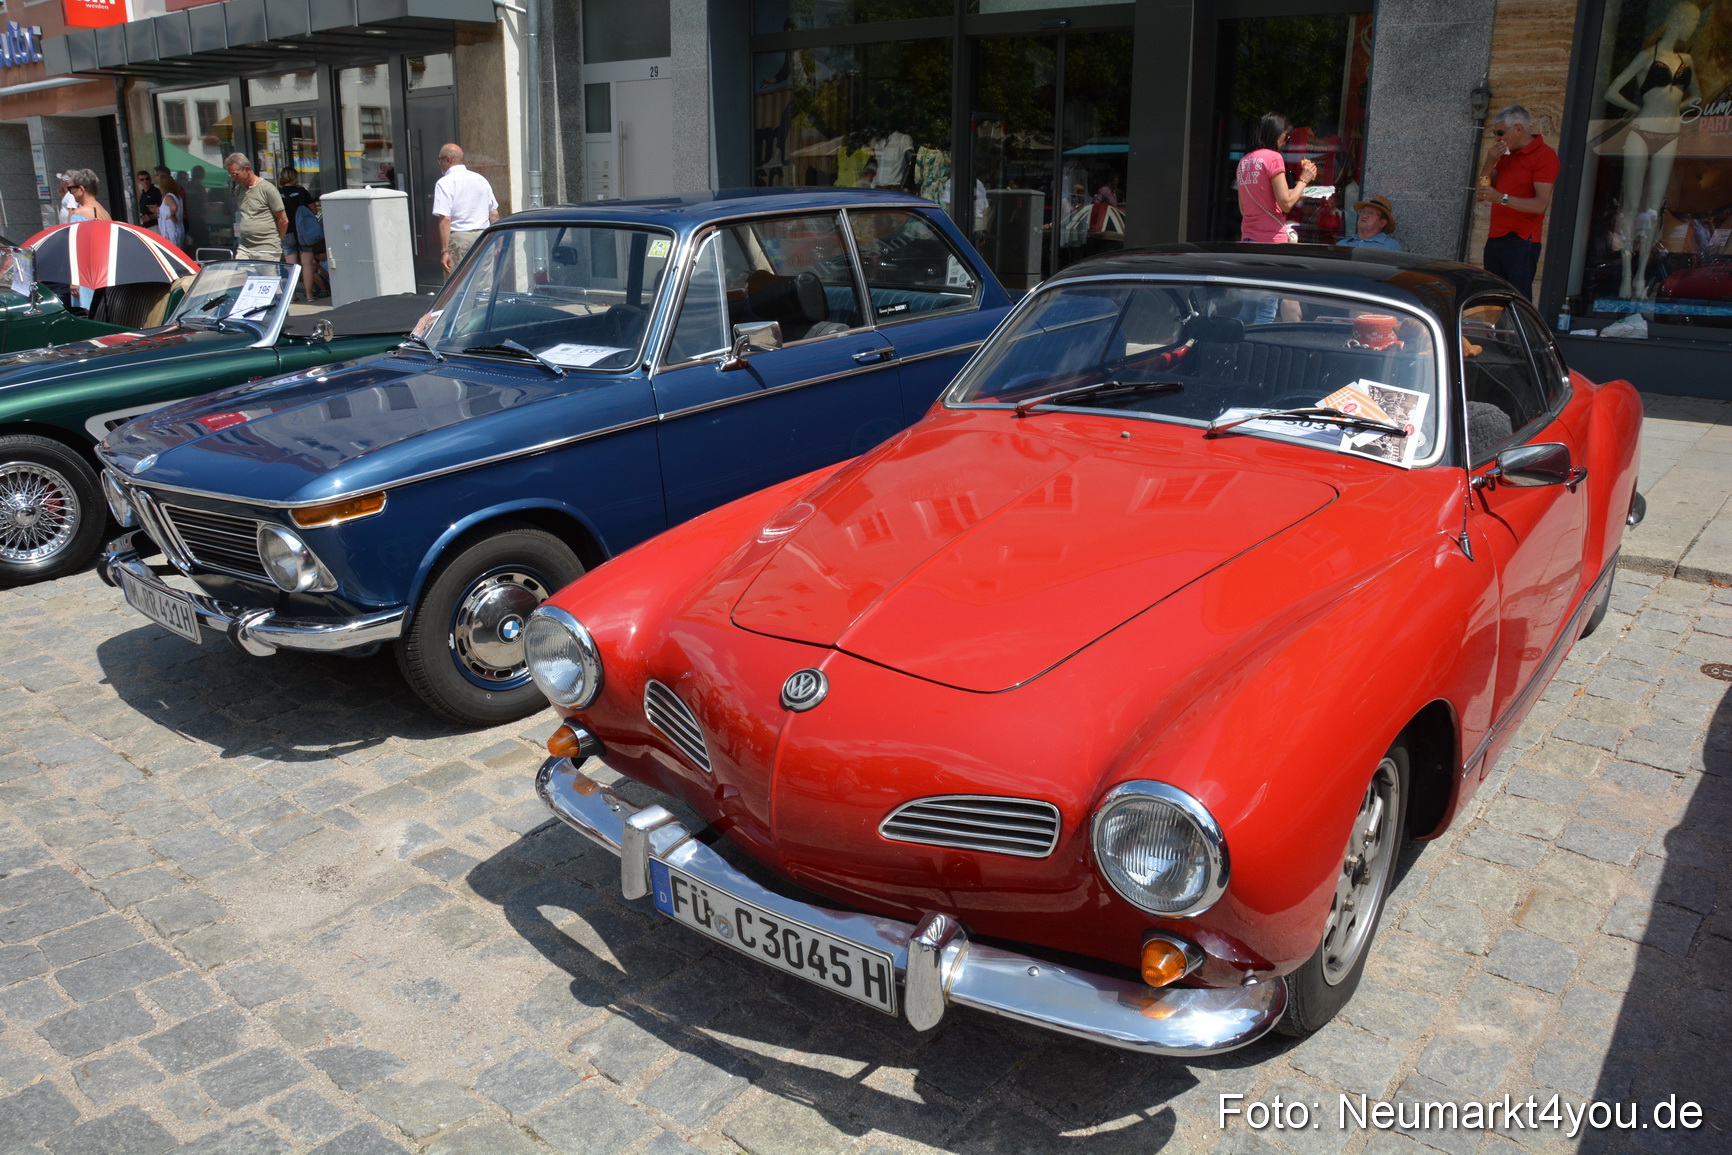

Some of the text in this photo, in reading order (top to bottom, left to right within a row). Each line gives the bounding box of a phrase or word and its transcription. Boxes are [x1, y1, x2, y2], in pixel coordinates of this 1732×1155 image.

[650, 65, 659, 78] 29
[257, 285, 272, 295] 196
[659, 890, 668, 903] D
